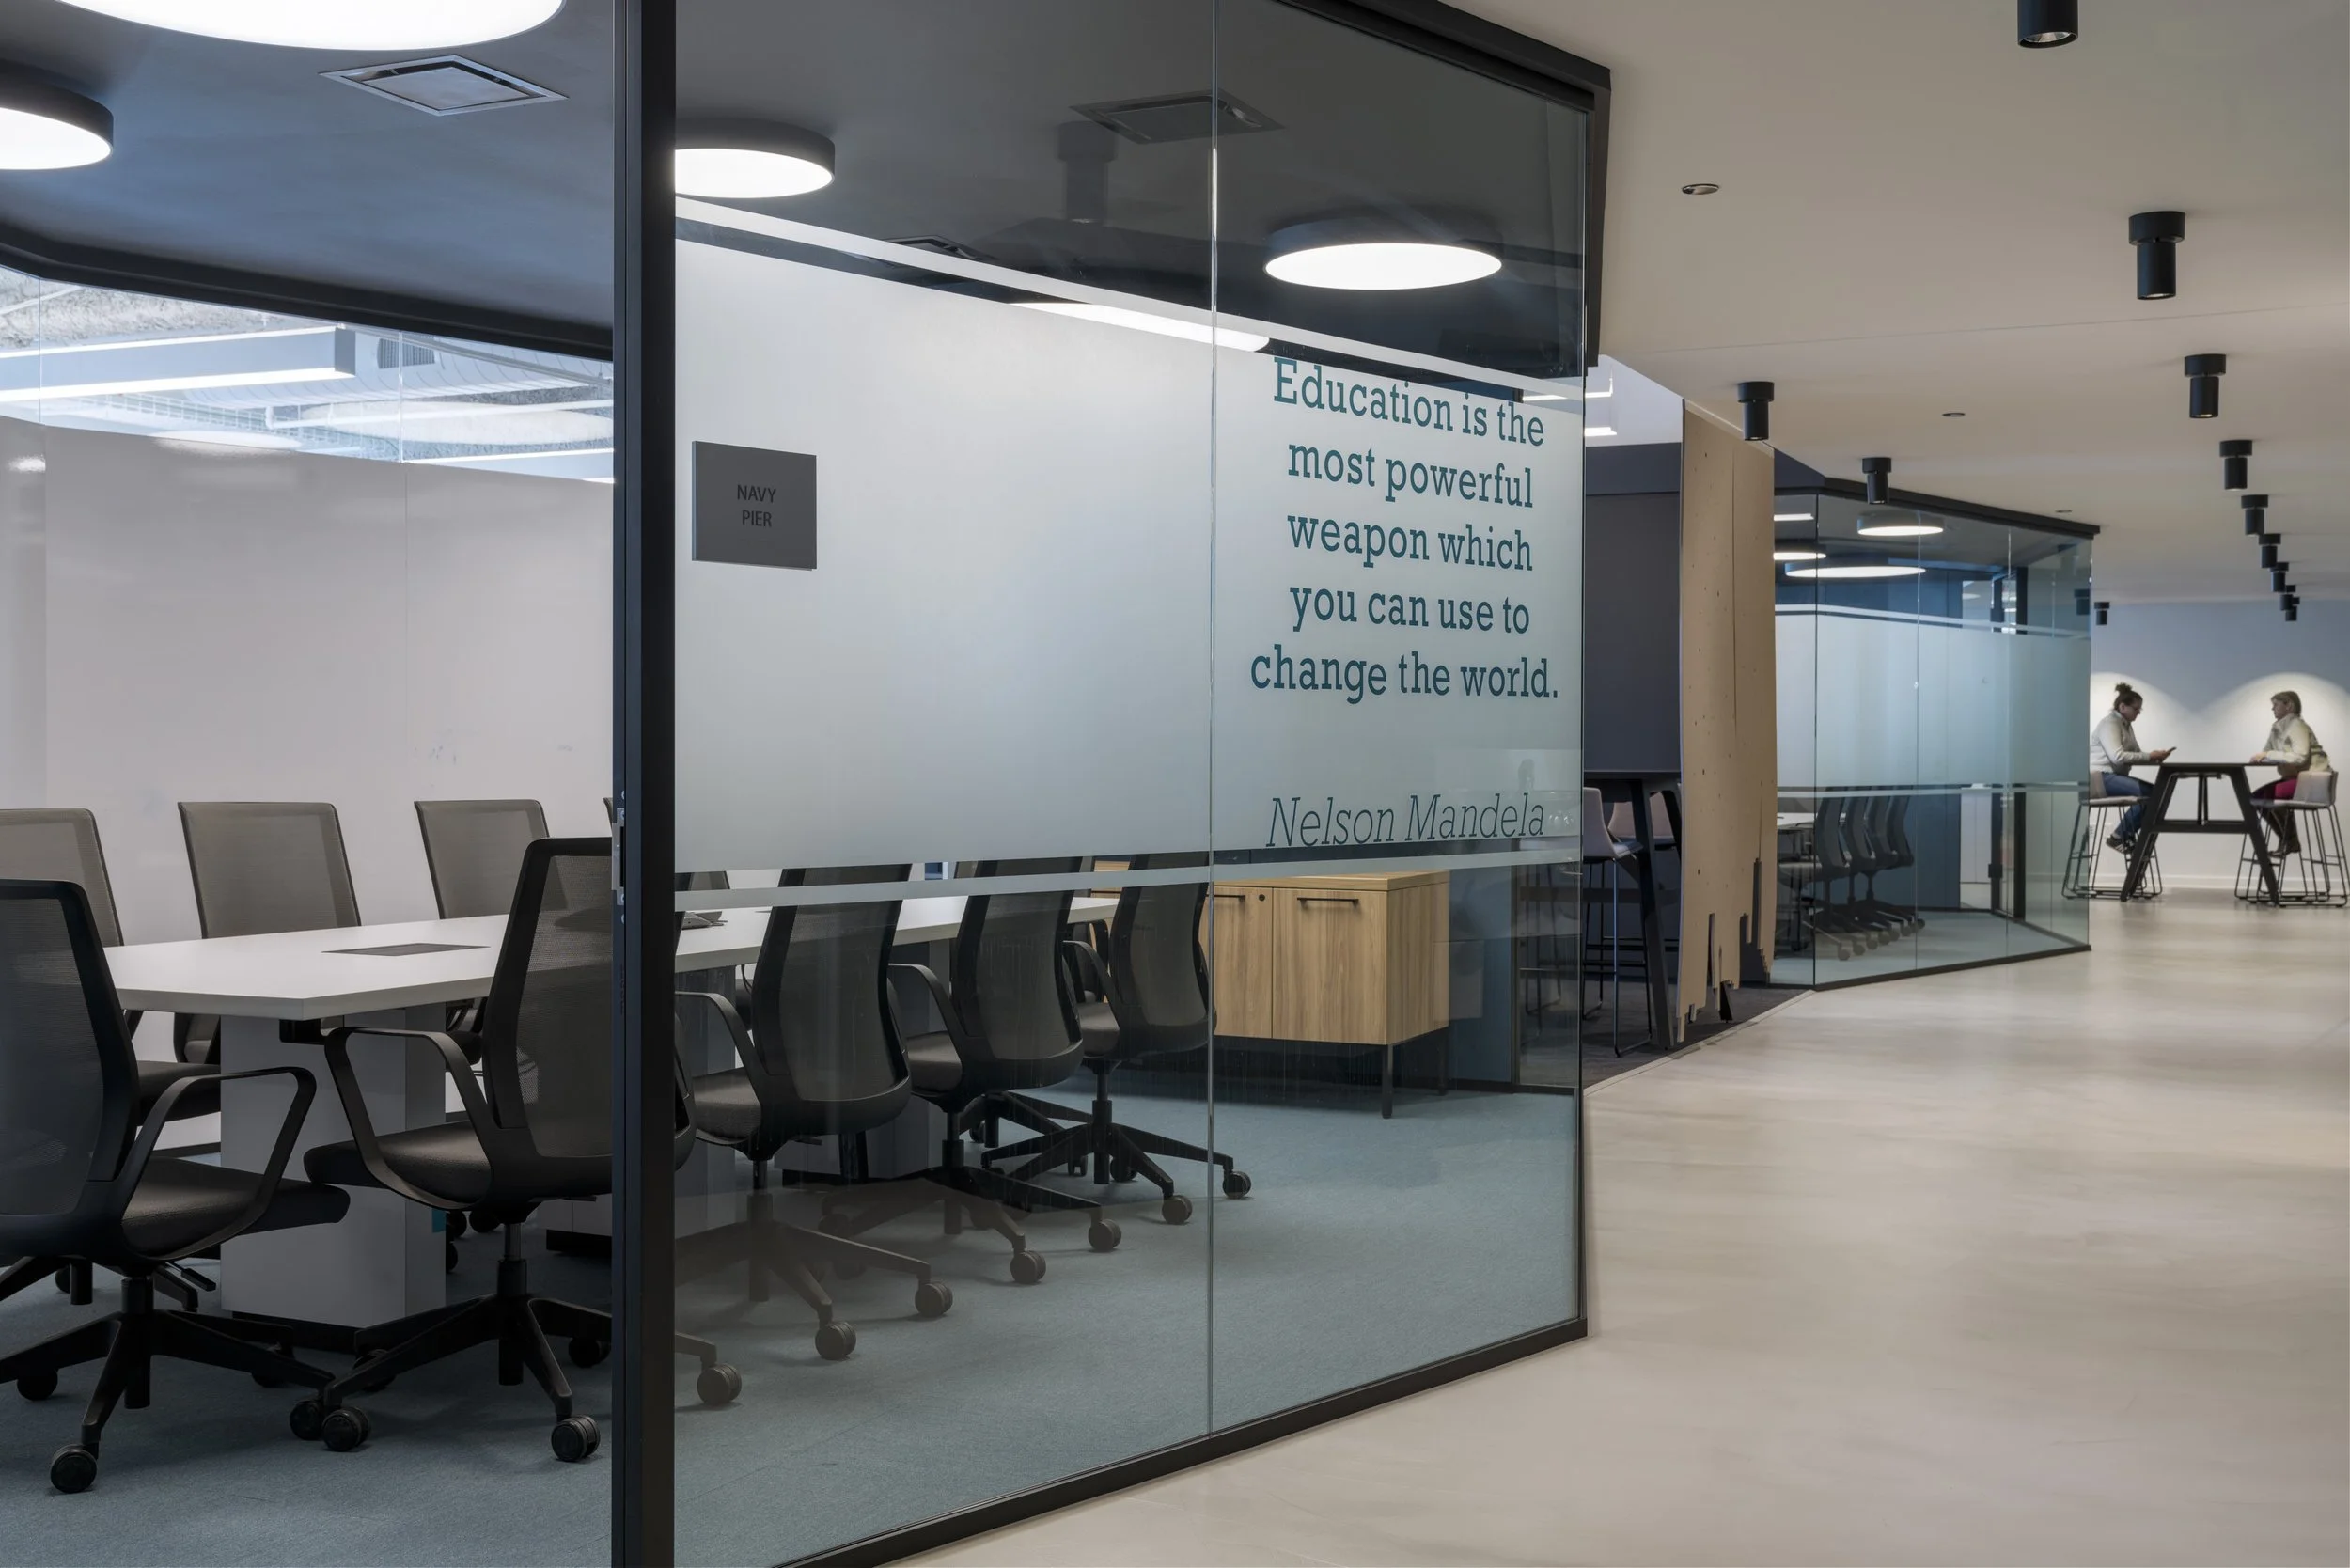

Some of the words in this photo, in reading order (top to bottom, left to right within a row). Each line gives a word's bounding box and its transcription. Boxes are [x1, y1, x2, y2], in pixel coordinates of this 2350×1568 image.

[1274, 357, 1453, 431] Education
[1462, 392, 1487, 436] is
[1497, 401, 1544, 447] the
[737, 484, 776, 503] NAVY
[1288, 444, 1375, 487] most
[1385, 458, 1533, 508] powerful
[742, 510, 772, 527] PIER
[1287, 515, 1430, 568] weapon
[1438, 524, 1533, 571] which
[1290, 587, 1357, 632] you
[1368, 592, 1429, 627] can
[1438, 599, 1494, 632] use
[1502, 597, 1530, 634] to
[1251, 644, 1386, 704] change
[1398, 651, 1450, 696] the
[1460, 657, 1558, 698] world.
[1266, 796, 1394, 847] Nelson
[1404, 792, 1544, 842] Mandela
